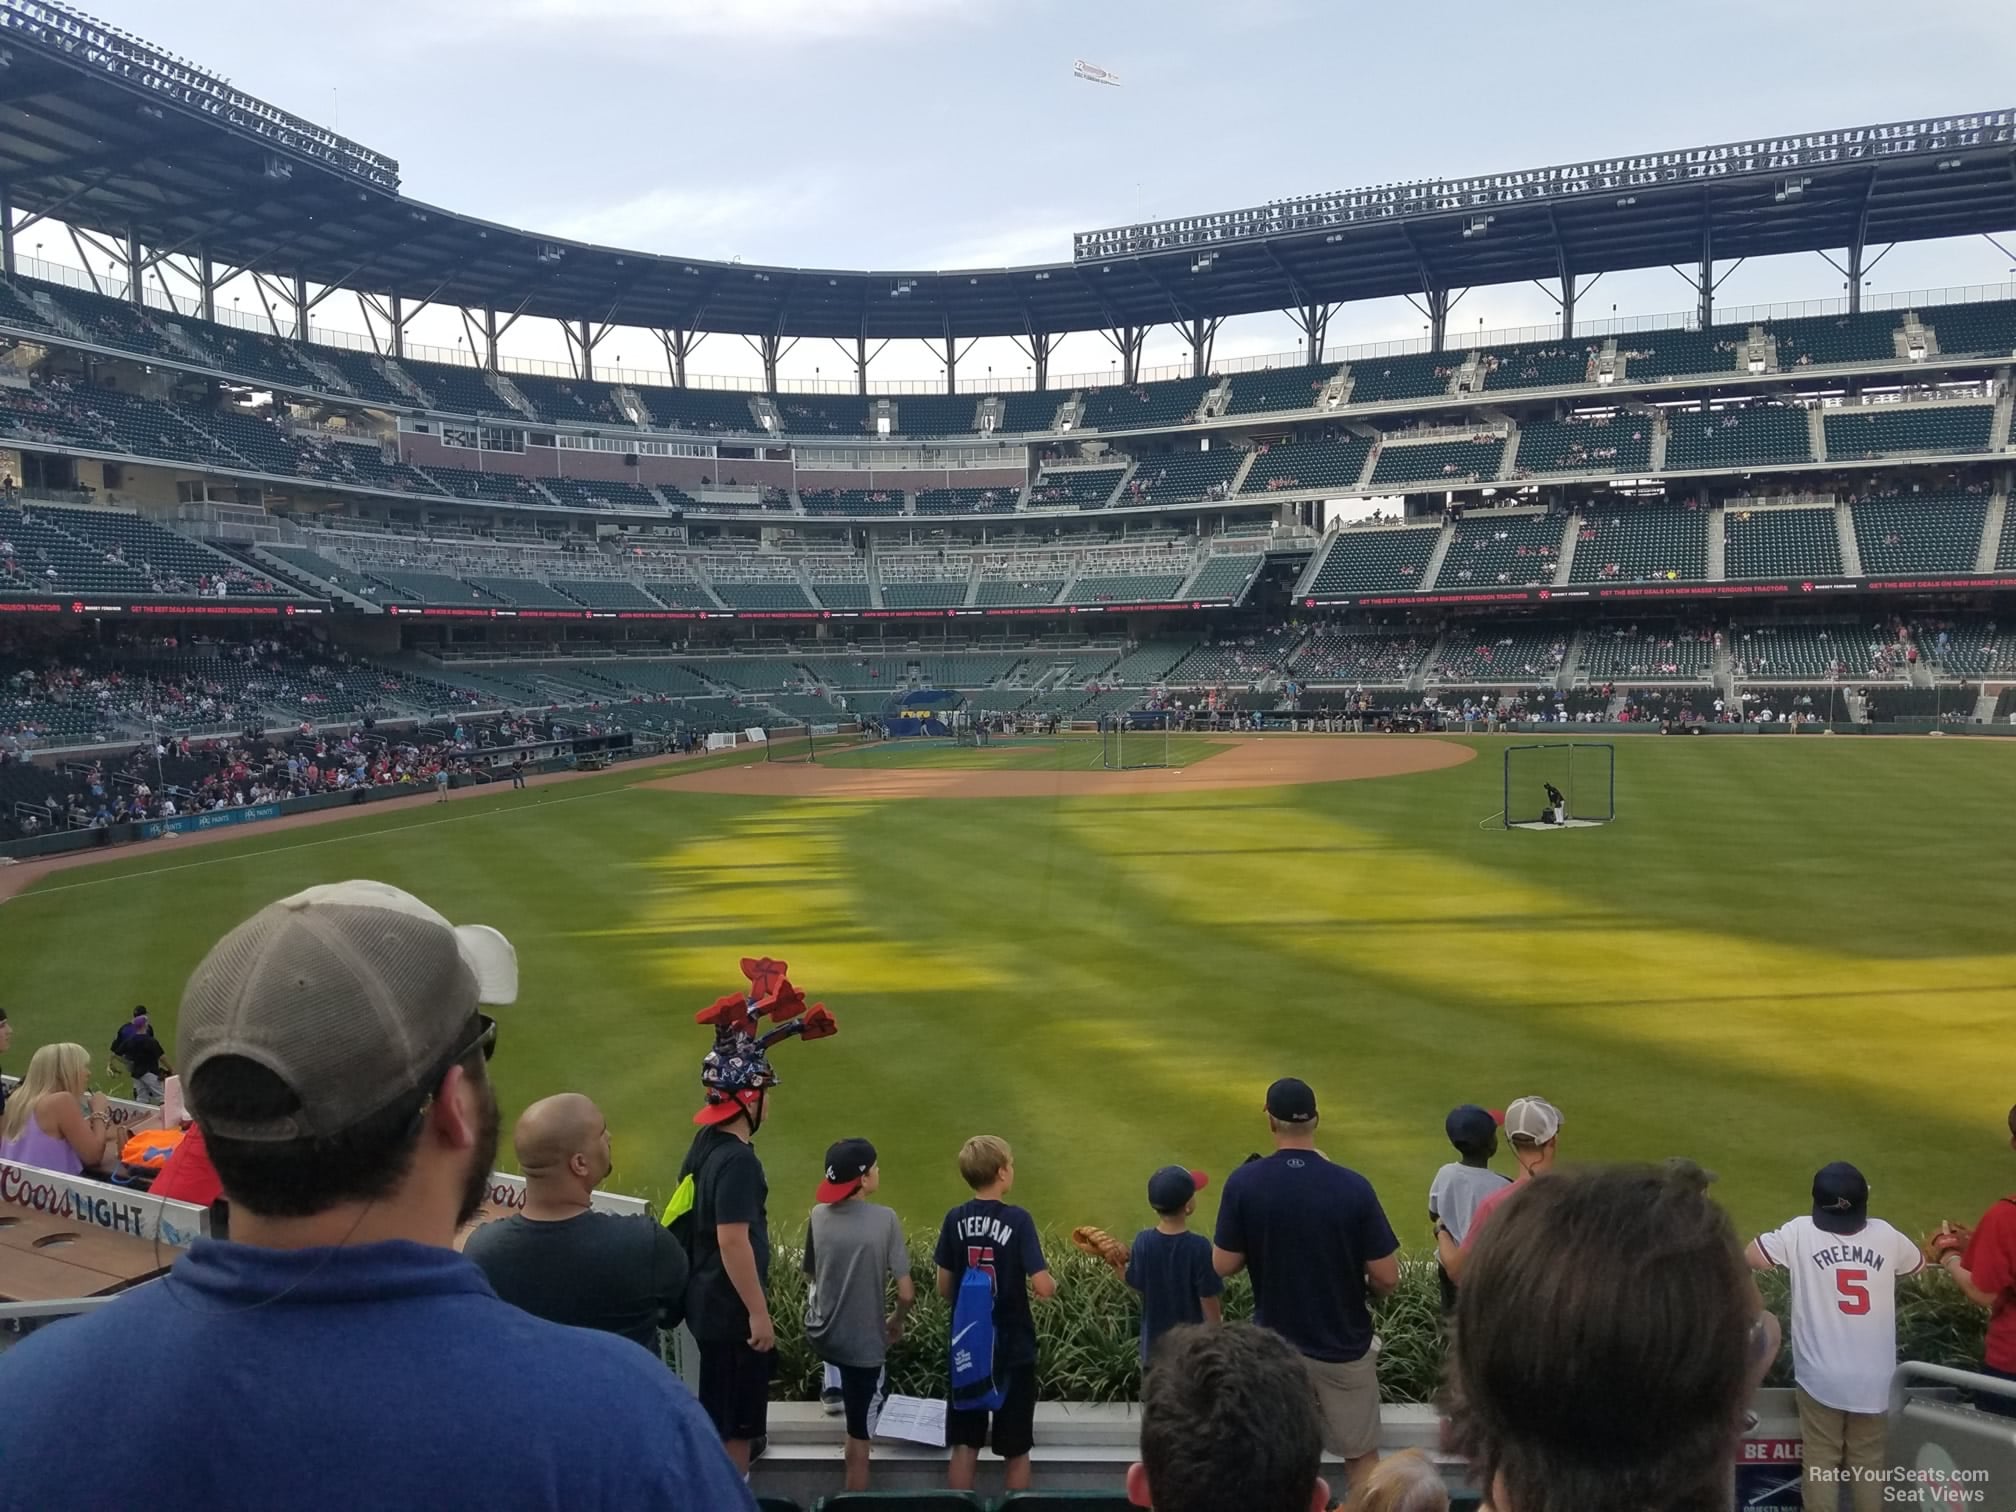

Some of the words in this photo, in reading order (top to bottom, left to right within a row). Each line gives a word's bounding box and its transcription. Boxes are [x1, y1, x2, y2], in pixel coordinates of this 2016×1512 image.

[0, 1166, 73, 1218] Coors
[75, 1193, 143, 1236] LIGHT
[1812, 1245, 1885, 1272] FREEMAN
[1836, 1268, 1871, 1315] 5
[1744, 1443, 1768, 1459] BE
